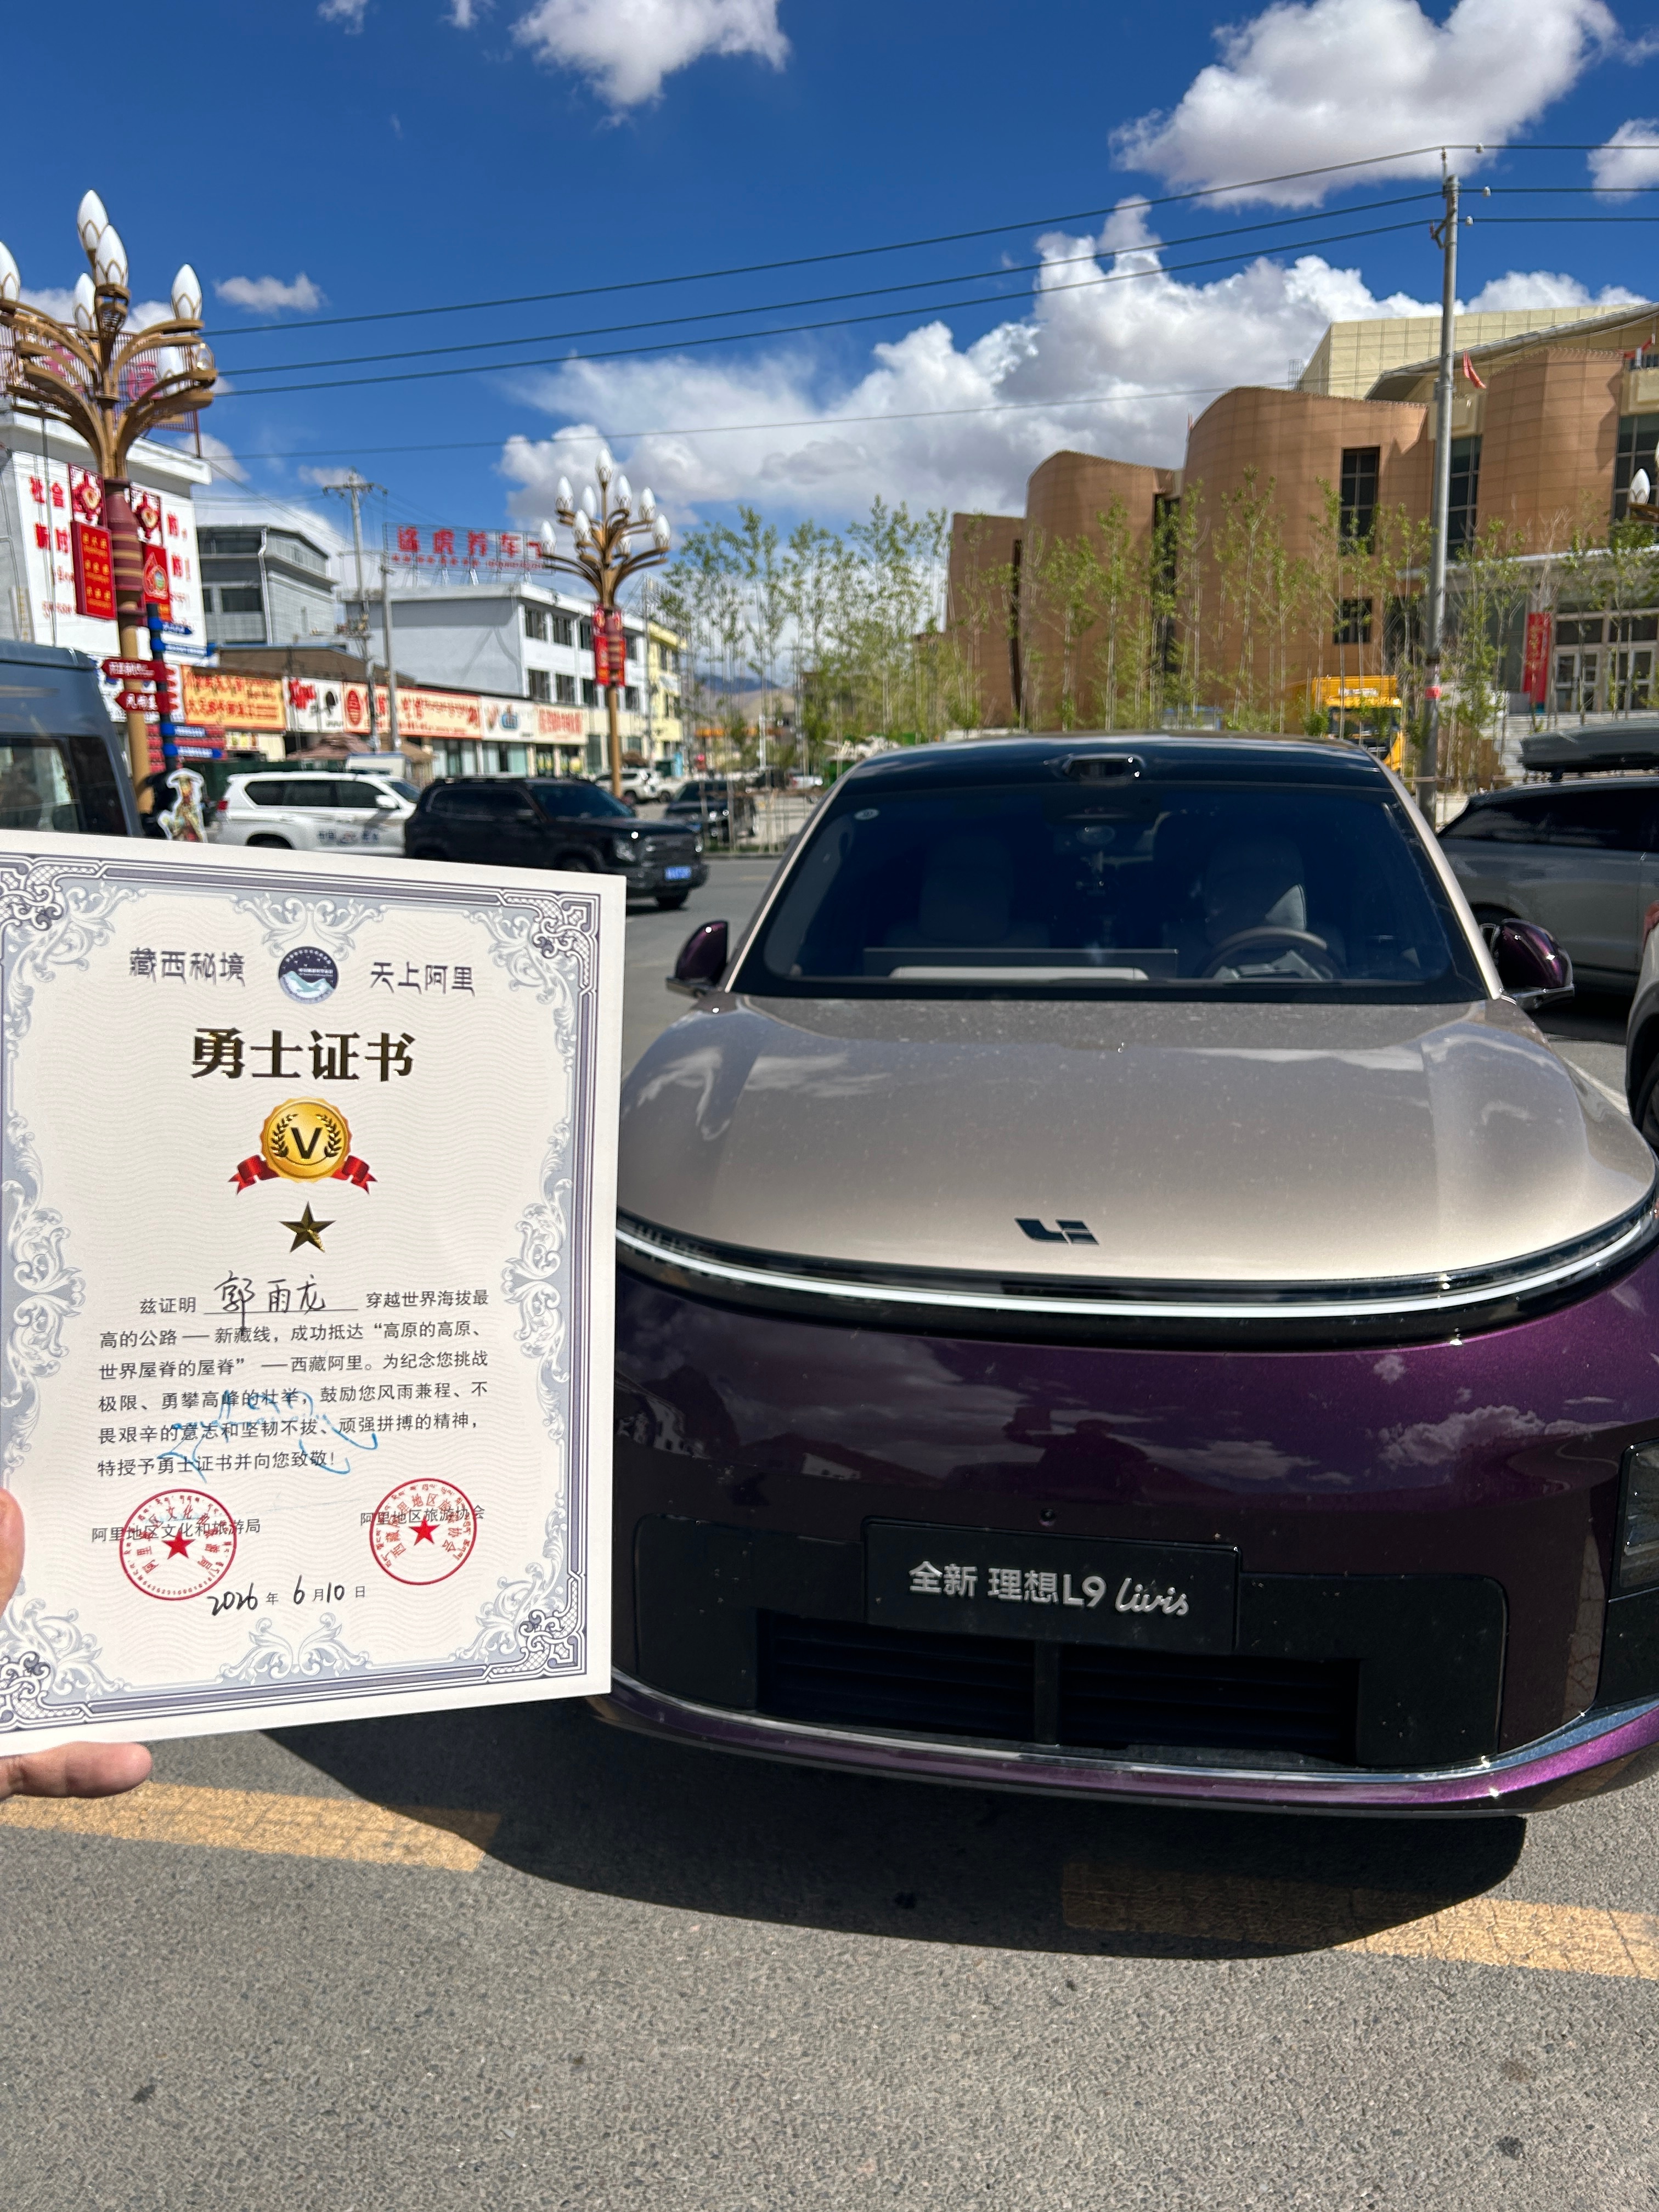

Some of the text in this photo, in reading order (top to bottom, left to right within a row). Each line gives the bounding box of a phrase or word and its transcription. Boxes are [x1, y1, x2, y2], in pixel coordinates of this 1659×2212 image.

[129, 947, 246, 987] 藏西秘境
[370, 962, 476, 996] 天上阿里
[191, 1027, 416, 1082] 勇士证书
[290, 1127, 323, 1159] V
[140, 1296, 196, 1314] 兹证明
[366, 1289, 489, 1308] 穿越世界海拔最
[97, 1449, 335, 1477] 特授予勇士证书并向您致敬！
[92, 1505, 485, 1543] 阿里地区文化和旅游局 阿里地区旅游协会
[909, 1561, 978, 1598] 全新
[988, 1567, 1107, 1609] 理想L9
